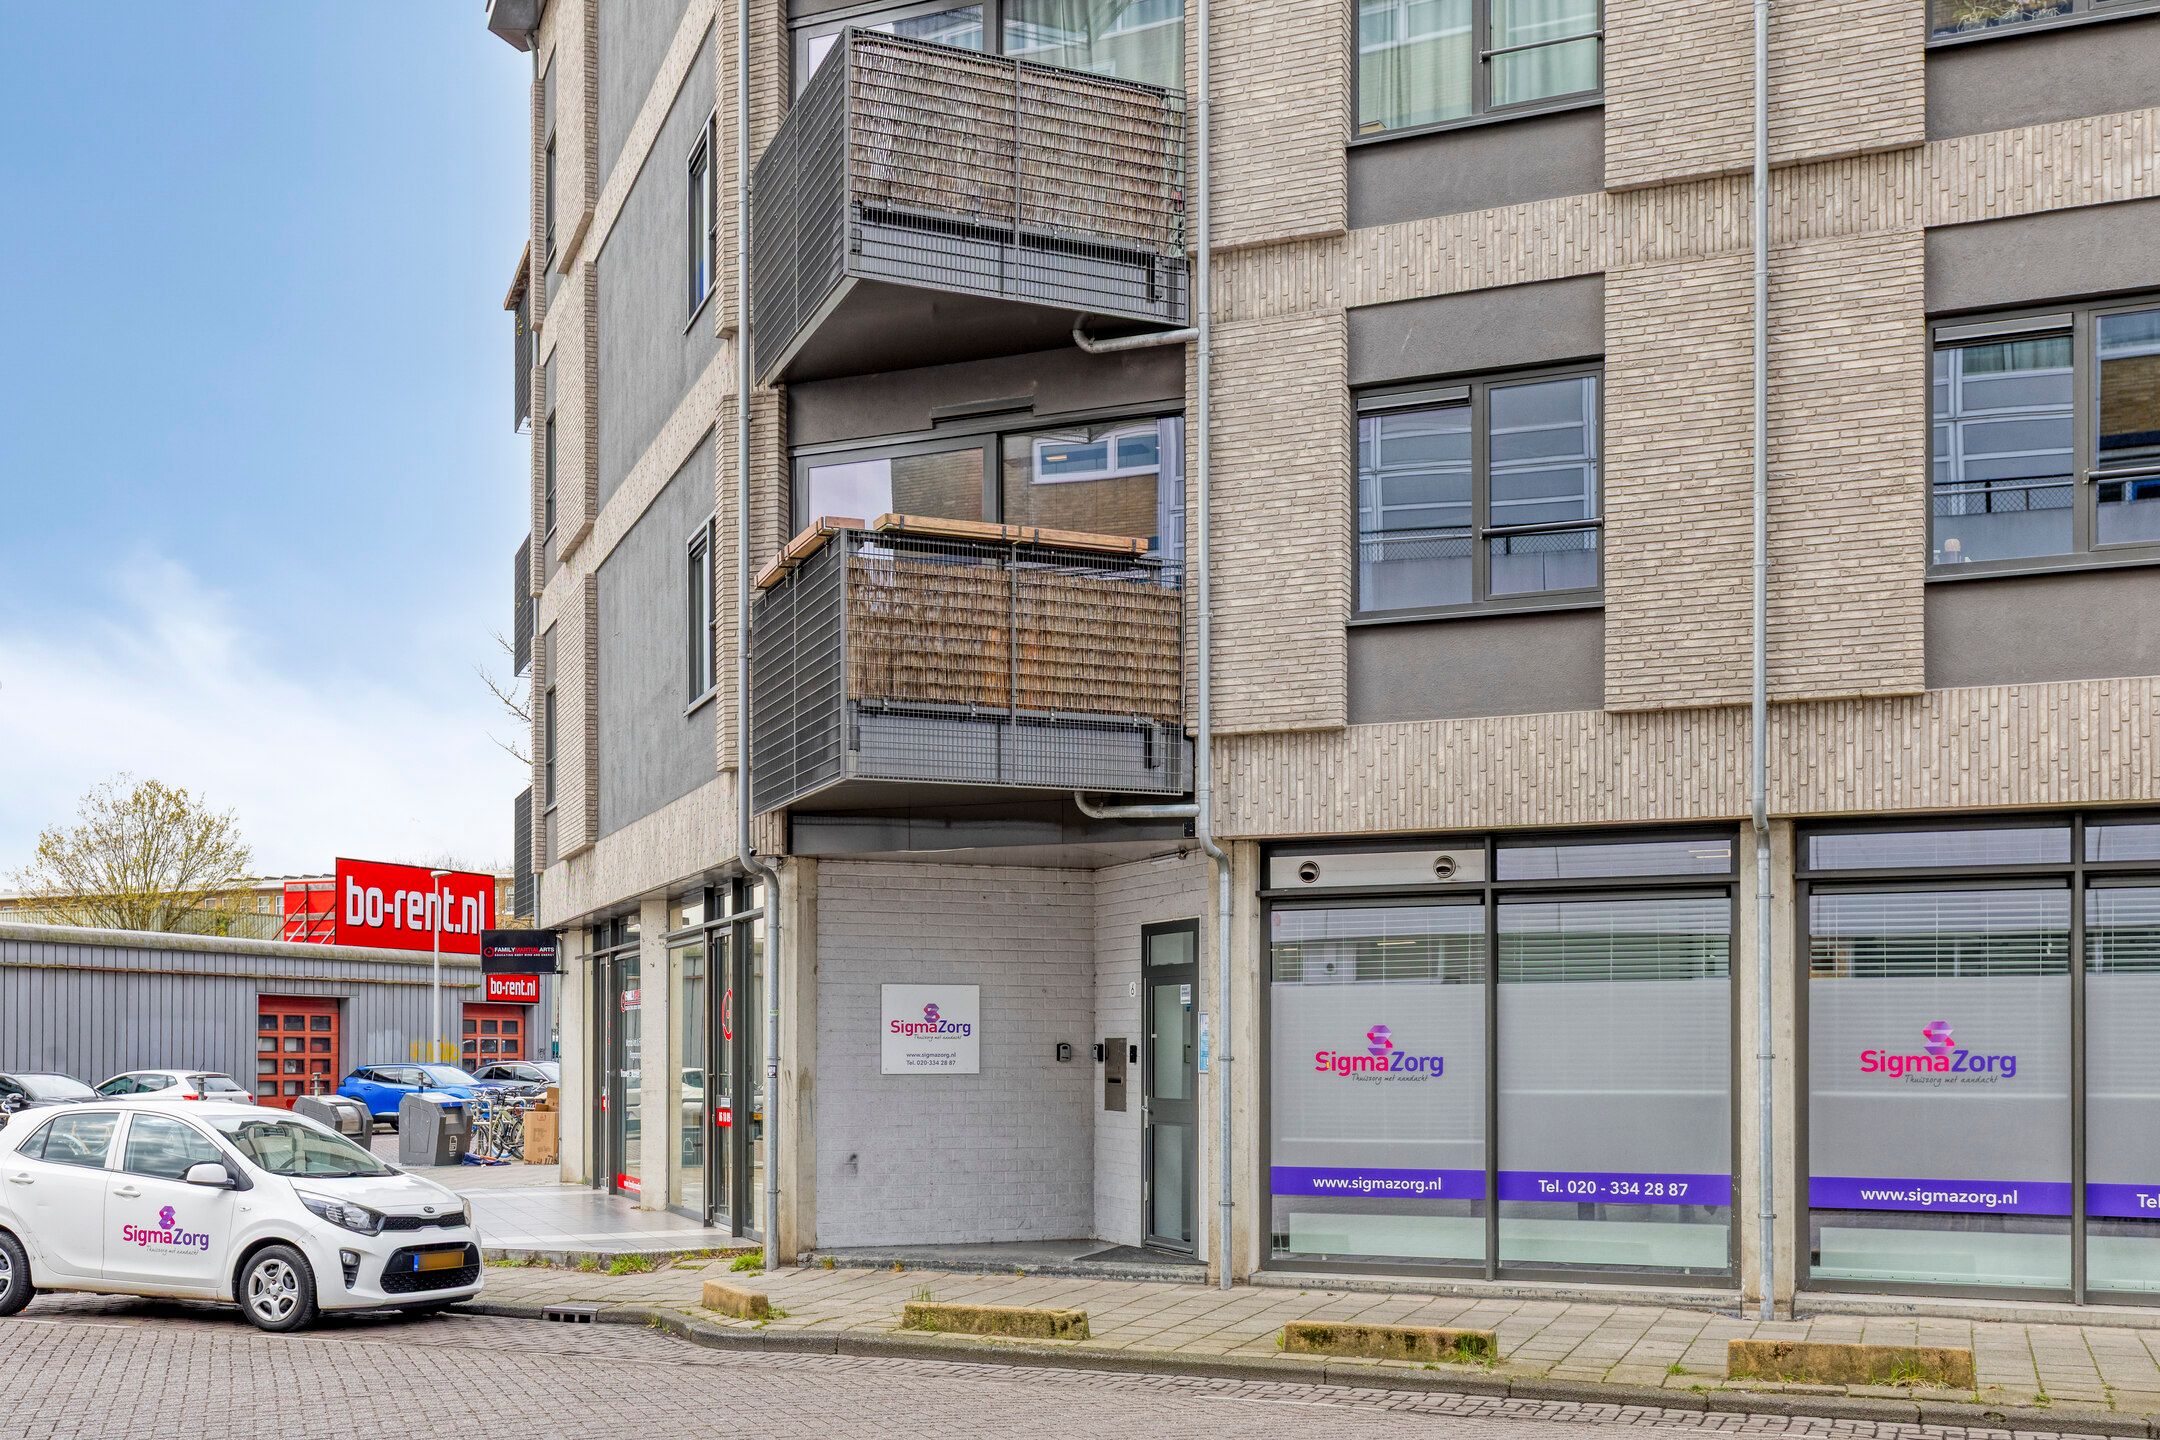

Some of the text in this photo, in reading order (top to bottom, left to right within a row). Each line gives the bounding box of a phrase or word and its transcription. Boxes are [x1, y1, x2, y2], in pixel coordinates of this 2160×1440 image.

[346, 875, 485, 935] bo-rent.nl
[490, 977, 536, 996] bo-rent.nl
[890, 1020, 971, 1037] SigmaZorg
[1315, 1051, 1444, 1077] SigmaZorg
[1860, 1049, 2017, 1078] SigmaZorg
[1351, 1073, 1382, 1085] Thuiszorg
[1397, 1074, 1428, 1082] aandacht
[1904, 1074, 1999, 1087] Thuiszorg met aandacht
[1313, 1176, 1442, 1194] www.sigmazorg.nl
[1538, 1179, 1564, 1193] Tel.
[1567, 1180, 1597, 1194] 020
[1610, 1181, 1640, 1196] 334
[1644, 1182, 1664, 1196] 28
[1668, 1183, 1688, 1197] 87
[1861, 1187, 2018, 1208] www.sigmazorg.nl
[123, 1224, 209, 1251] SigmaZorg
